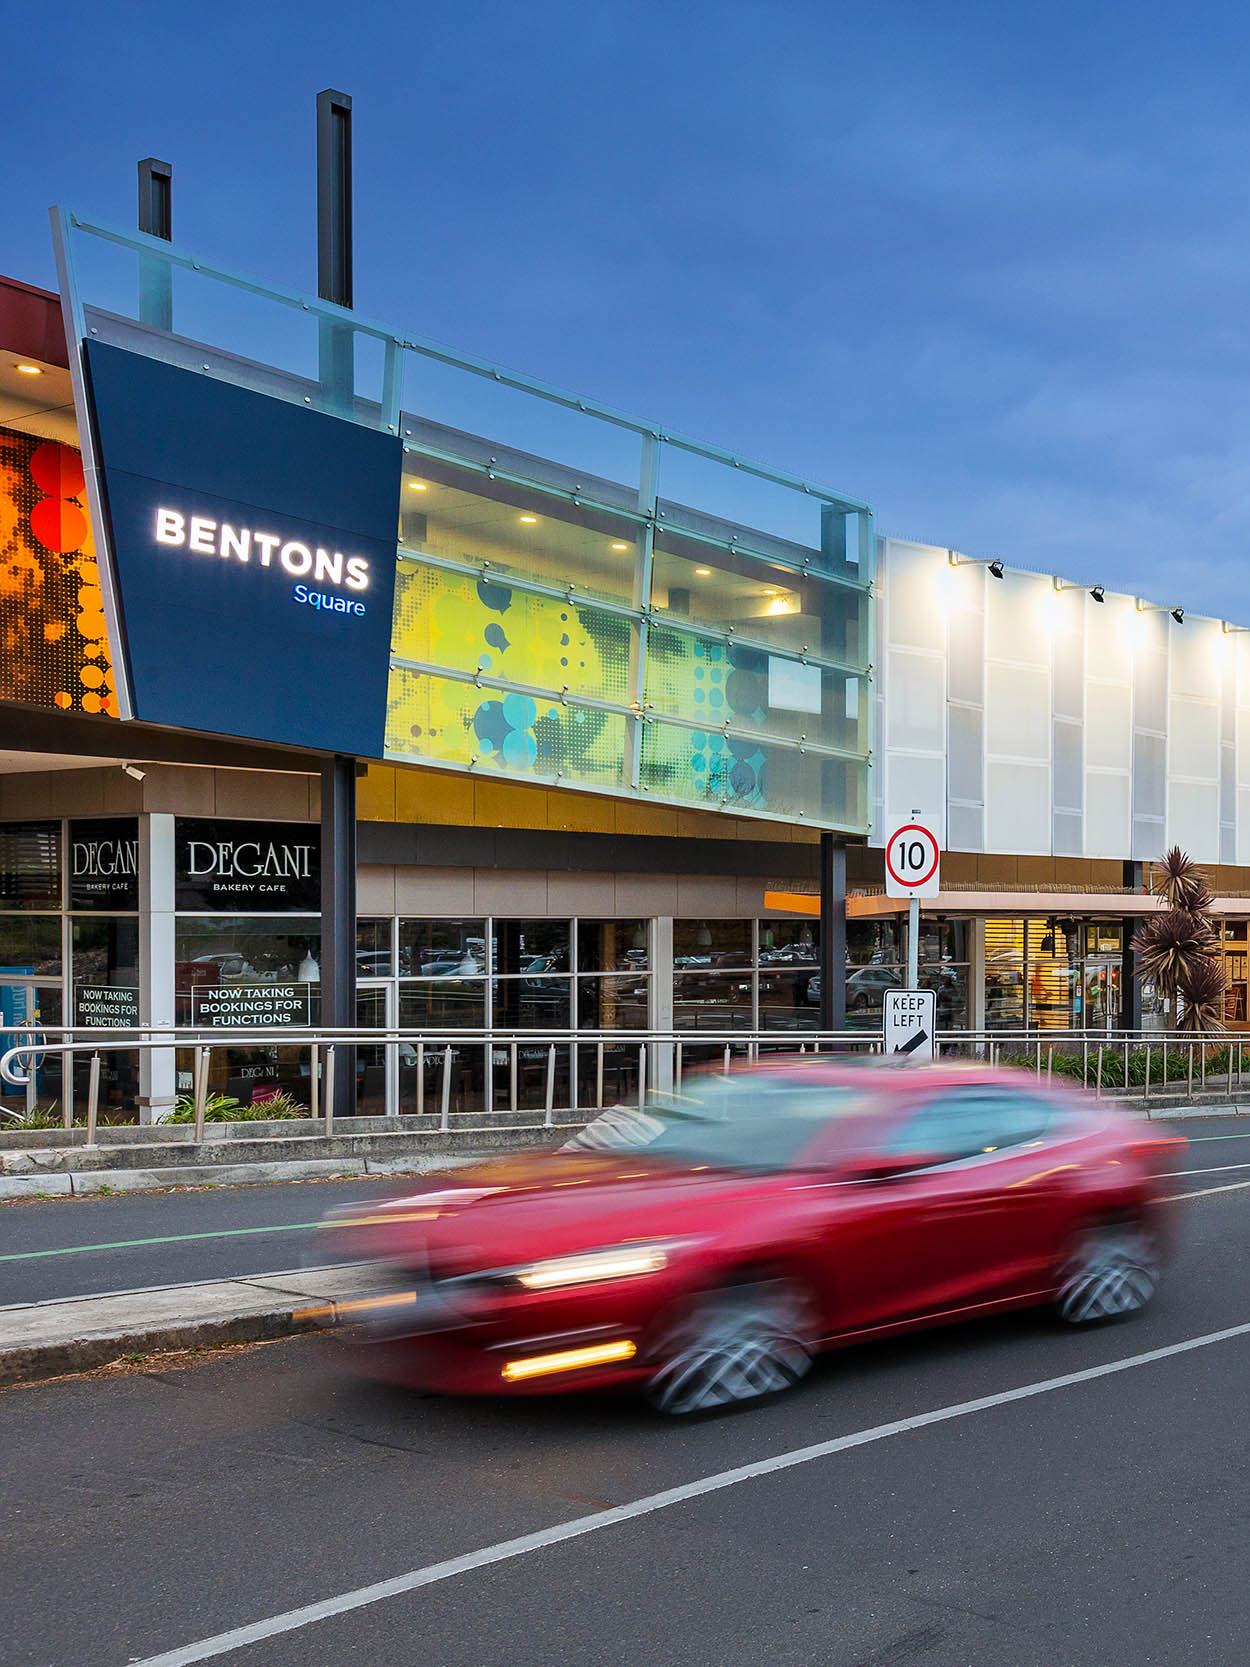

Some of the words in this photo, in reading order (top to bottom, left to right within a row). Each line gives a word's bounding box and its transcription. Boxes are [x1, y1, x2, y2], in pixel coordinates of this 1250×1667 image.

[155, 507, 370, 590] BENTONS
[293, 583, 367, 617] Square
[73, 840, 139, 876] DEGAN
[187, 841, 311, 879] DEGANI
[899, 841, 925, 870] 10
[213, 883, 255, 891] BAKERY
[259, 884, 286, 892] CAFE
[83, 990, 103, 1000] NOW
[104, 991, 133, 1001] TAKING
[208, 989, 243, 1000] NOW
[244, 987, 295, 998] TAKING
[79, 1003, 120, 1014] BOOKINGS
[121, 1005, 138, 1015] FOR
[200, 1001, 273, 1013] BOOKINGS
[275, 1000, 303, 1010] FOR
[892, 998, 925, 1010] KEEP
[85, 1016, 131, 1027] FUNCTIONS
[212, 1013, 292, 1026] FUNCTIONS
[893, 1014, 924, 1027] LEFT
